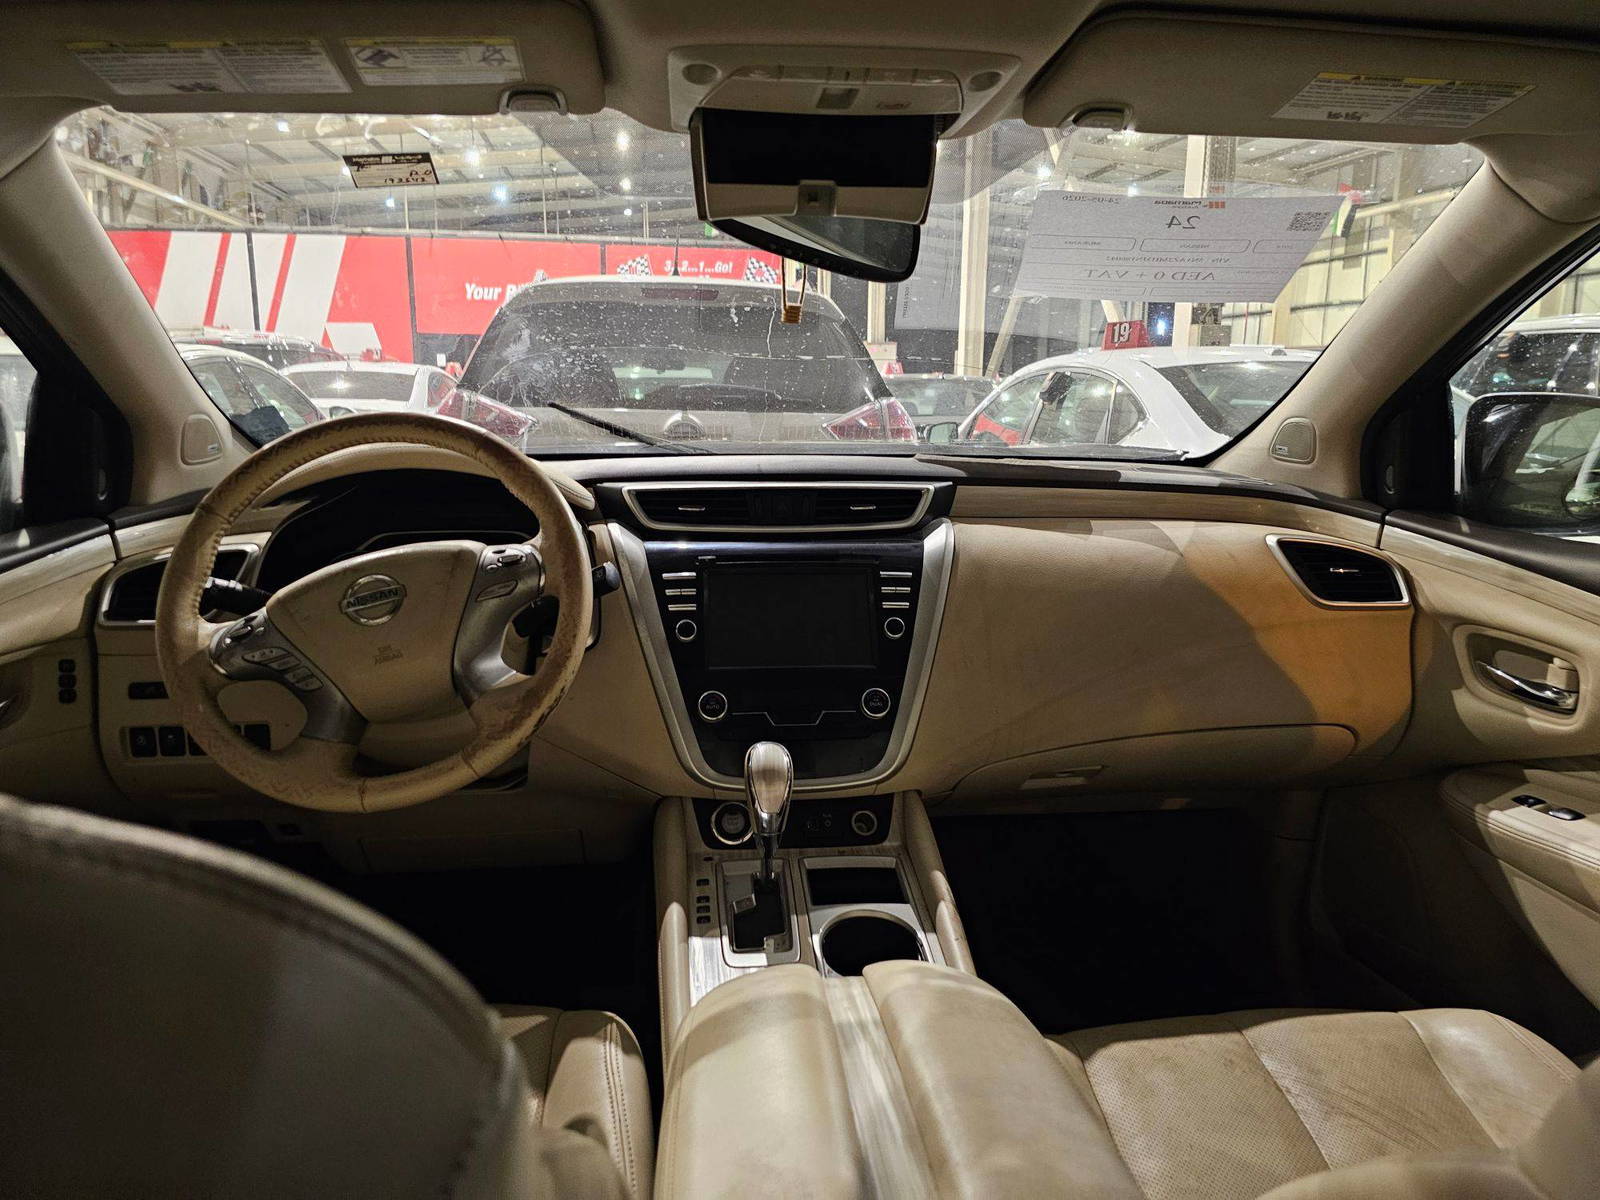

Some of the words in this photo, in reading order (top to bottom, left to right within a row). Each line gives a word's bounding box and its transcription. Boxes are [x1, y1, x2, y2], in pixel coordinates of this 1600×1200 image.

[464, 282, 502, 301] Your
[1112, 322, 1131, 343] 19
[346, 588, 400, 609] NISSAN
